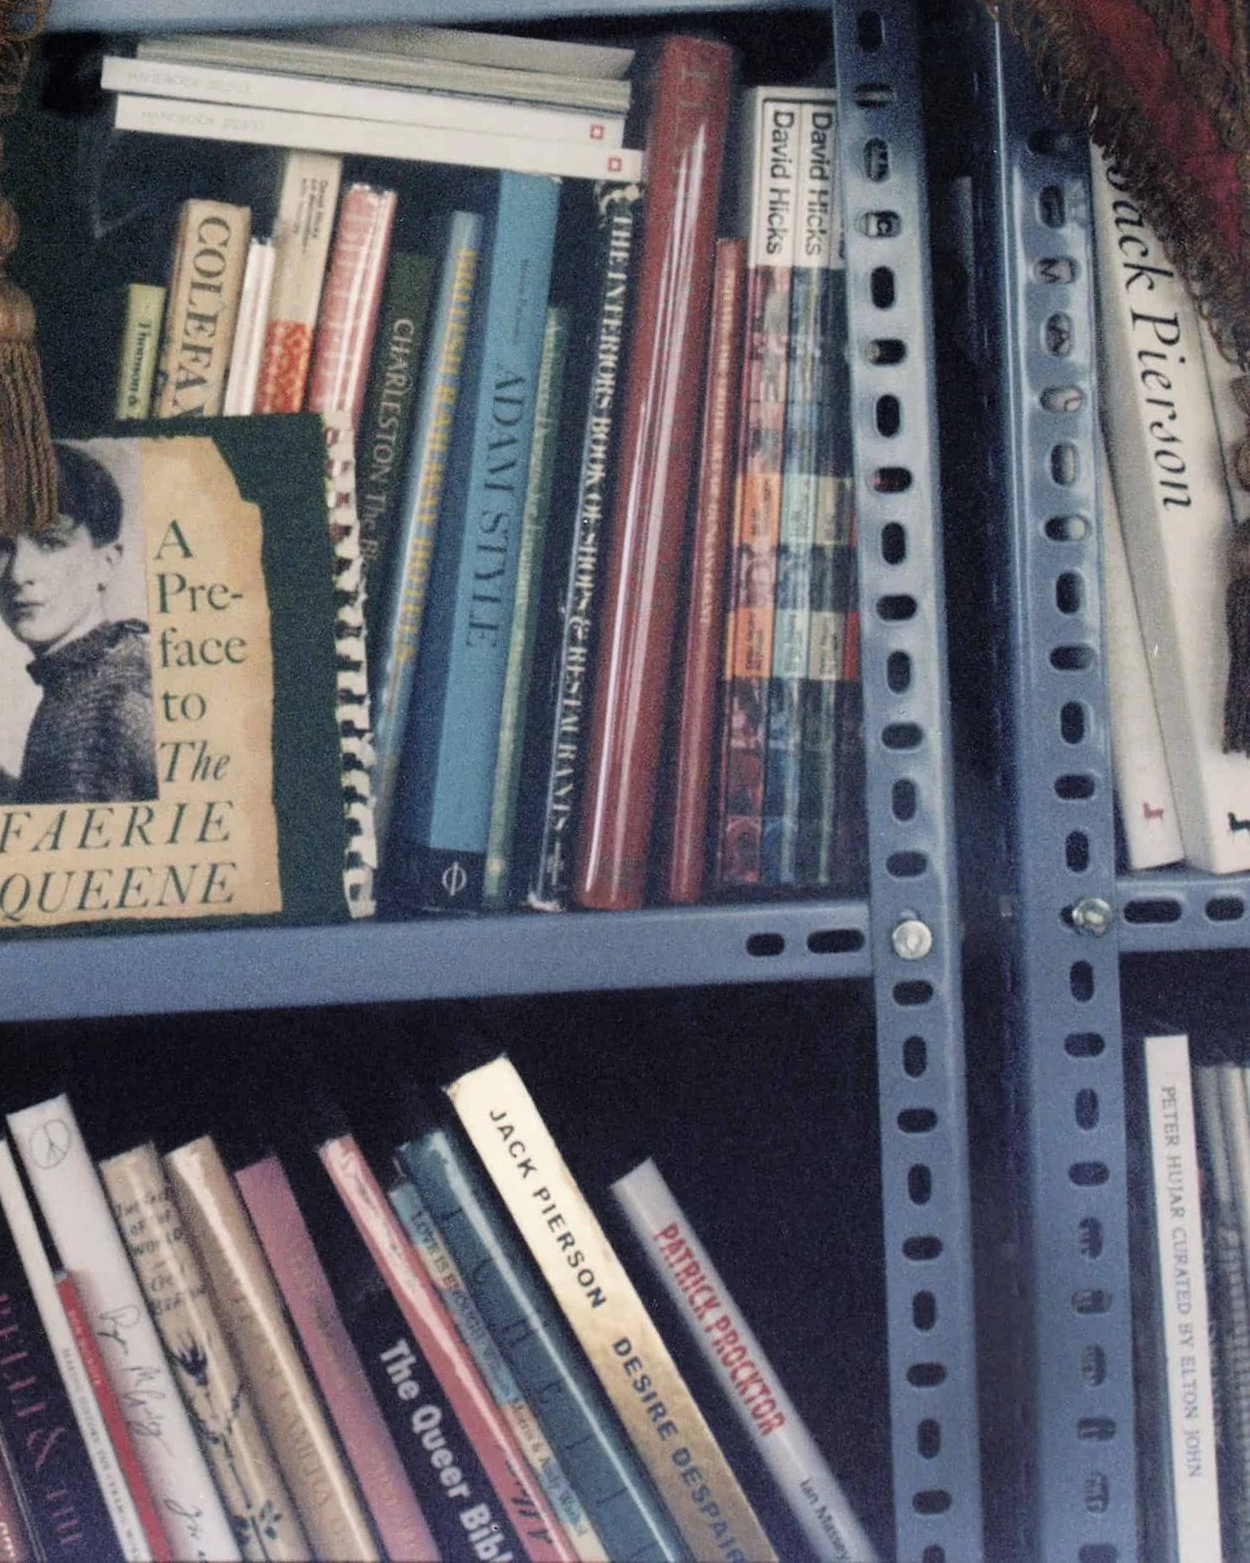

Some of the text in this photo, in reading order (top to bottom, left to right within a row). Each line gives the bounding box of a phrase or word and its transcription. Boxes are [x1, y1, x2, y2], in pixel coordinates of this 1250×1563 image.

[762, 109, 797, 255] David Hicks
[803, 111, 834, 256] David Hicks
[438, 247, 482, 379] BRITISH
[365, 315, 418, 484] CHARLESTON
[413, 384, 459, 526] RAILWAY
[482, 372, 527, 494] ADAM
[1130, 309, 1192, 510] Pierson
[154, 520, 193, 560] A
[361, 492, 388, 533] The
[463, 510, 513, 650] STYLE
[549, 212, 633, 832] THE INTERIORS BOOK OF SHOPS & RESTAURANTS
[156, 573, 244, 613] Pre-
[160, 625, 247, 667] face
[158, 741, 230, 784] The
[161, 687, 206, 722] to
[407, 1208, 444, 1258] LOVE
[504, 1394, 541, 1443] Morris
[484, 1103, 539, 1181] JACK
[528, 1184, 610, 1311] PIERSON
[608, 1335, 680, 1442] DESIRE
[648, 1220, 789, 1439] PATRICK PROCKTOR
[1158, 1085, 1207, 1478] PETER HUJAR CURATED BY ELTON JOHN
[374, 1336, 482, 1503] The Queer
[796, 1476, 824, 1507] Ian
